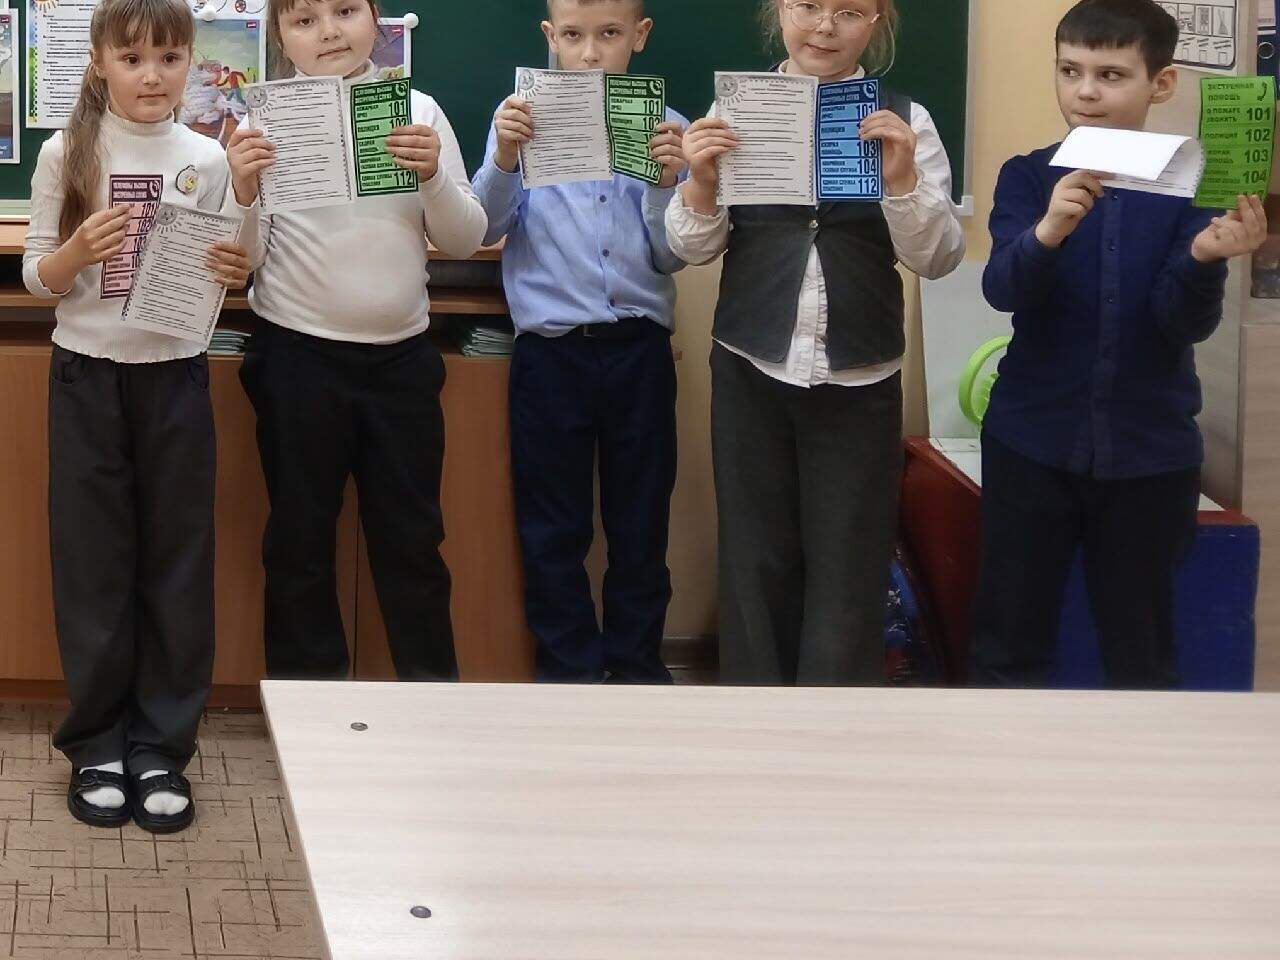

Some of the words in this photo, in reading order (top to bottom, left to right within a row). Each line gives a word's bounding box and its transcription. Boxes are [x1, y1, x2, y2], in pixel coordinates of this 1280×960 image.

[389, 101, 405, 117] 101
[643, 100, 660, 113] 101
[1246, 107, 1271, 120] 101
[1246, 129, 1270, 142] 102
[857, 140, 876, 156] 103
[1245, 149, 1268, 163] 103
[644, 161, 659, 179] 112
[858, 159, 876, 174] 104
[394, 171, 412, 185] 112
[1243, 169, 1267, 183] 104
[858, 178, 876, 193] 112
